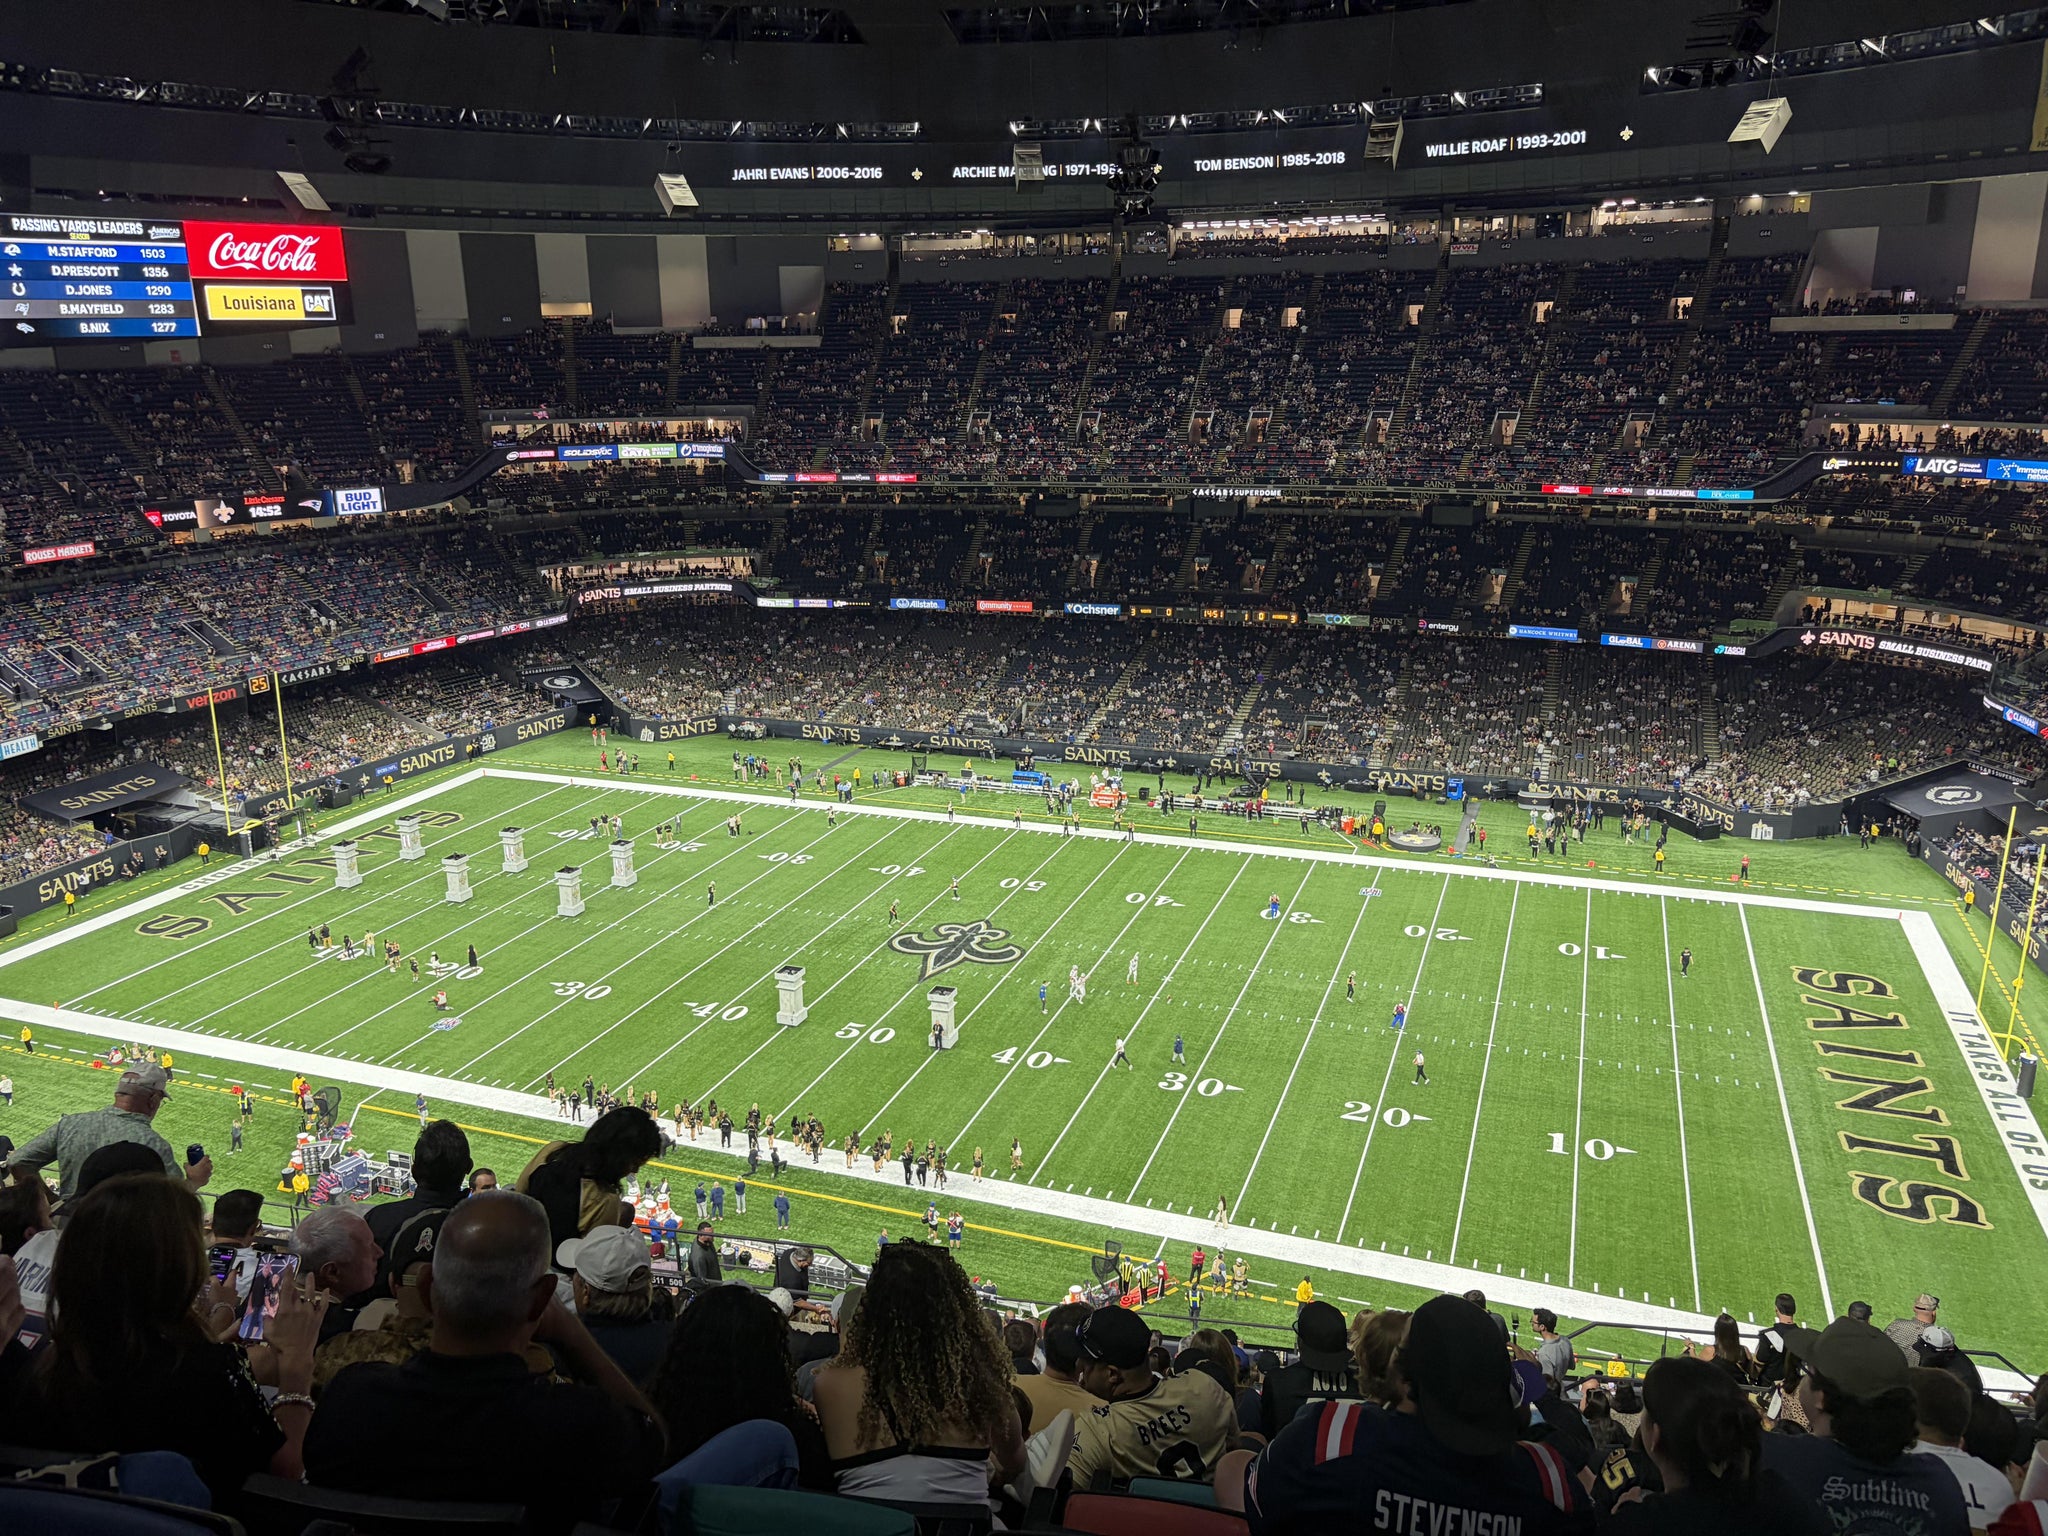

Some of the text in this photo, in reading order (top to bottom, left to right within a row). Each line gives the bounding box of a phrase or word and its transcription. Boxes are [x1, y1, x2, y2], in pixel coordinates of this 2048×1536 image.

[1426, 130, 1587, 158] WILLIE ROAF 1993-2001
[1194, 151, 1346, 172] TOM BENSON 1985-2018
[731, 166, 883, 181] JAHRI EVANS 2006-2016
[952, 165, 997, 179] ARCHIE
[999, 163, 1058, 178] MANG
[12, 217, 144, 235] PASSING YARDS LEADERS
[47, 245, 166, 259] M.STAFFORD 1503
[50, 264, 169, 278] D.PRESCOTT 1356
[65, 284, 172, 296] D.JONES 1290
[59, 303, 175, 315] B.MAYFIELD 1283
[222, 294, 297, 311] Louisiana
[304, 294, 331, 313] CAT
[79, 321, 177, 334] B.NIX 1277
[1914, 458, 1958, 474] LATG
[921, 474, 950, 482] SAINTS
[981, 474, 1009, 482] SAINTS
[1100, 475, 1129, 483] SAINTS
[1161, 476, 1191, 484] SAINTS
[1225, 477, 1255, 485] SAINTS
[1289, 477, 1320, 486] SAINTS
[1356, 478, 1387, 487] SAINTS
[1423, 480, 1456, 489] SAINTS
[583, 490, 610, 499] SAINTS
[640, 487, 668, 496] SAINTS
[1192, 488, 1281, 497] CAESARS SUPERDOME
[1494, 482, 1527, 491] SAINTS
[344, 491, 373, 504] BUD
[248, 504, 283, 518] 14:52
[340, 500, 378, 513] LIGHT
[1771, 504, 1807, 514] SAINTS
[1854, 508, 1890, 518] SAINTS
[161, 511, 197, 522] TOYOTA
[1932, 514, 1968, 526] SAINTS
[2009, 522, 2043, 535] SAINTS
[123, 534, 155, 546] SAINTS
[25, 546, 56, 562] ROUSES
[57, 542, 95, 557] MARKETS
[584, 583, 733, 603] SAINTS SMALL BUSINESS PARTNERS
[979, 602, 1013, 611] Community
[1072, 604, 1119, 615] Ochsner
[1325, 614, 1351, 625] COX
[1372, 616, 1403, 626] SAINTS
[1427, 622, 1460, 632] entergy
[1518, 628, 1578, 639] HANCOCK WHITNEY
[1666, 640, 1697, 650] ARENA
[1818, 630, 1966, 665] SAINTS SMALL BUSINESS
[336, 655, 365, 668] SAINTS
[280, 665, 332, 685] CAESARS
[251, 676, 269, 692] 25
[185, 686, 238, 710] verzon
[124, 702, 158, 719] SAINTS
[47, 722, 84, 739] SAINTS
[517, 714, 567, 741] SAINTS
[659, 713, 718, 740] SAINTS
[801, 724, 861, 742] SAINTS
[3, 737, 37, 756] HEALTH
[929, 735, 991, 750] SAINTS
[400, 743, 455, 775] SAINTS
[1064, 746, 1131, 763] SAINTS
[60, 774, 157, 810] SAINTS
[1536, 783, 1619, 801] SANTS
[768, 851, 815, 866] 30
[881, 864, 927, 878] 40
[1945, 862, 1975, 894] SAITS
[998, 877, 1048, 892] 50
[1125, 892, 1177, 908] 40
[1404, 925, 1463, 943] 20
[1558, 942, 1611, 959] 10
[553, 981, 613, 1001] 30
[690, 1001, 750, 1021] 40
[1947, 1010, 1979, 1027] IT
[834, 1021, 897, 1045] 50
[990, 1046, 1054, 1070] 40
[1964, 1032, 2009, 1083] TAKES
[1157, 1071, 1227, 1098] 30
[1789, 964, 1995, 1230] SAINTS
[1985, 1088, 2028, 1122] ALL
[1340, 1100, 1412, 1128] 20
[1545, 1132, 1617, 1161] 10
[2005, 1130, 2046, 1157] OF
[668, 1277, 684, 1287] 509
[1136, 1403, 1192, 1446] BREES
[1821, 1475, 1930, 1512] Sublime
[1372, 1488, 1523, 1536] STEVENSON
